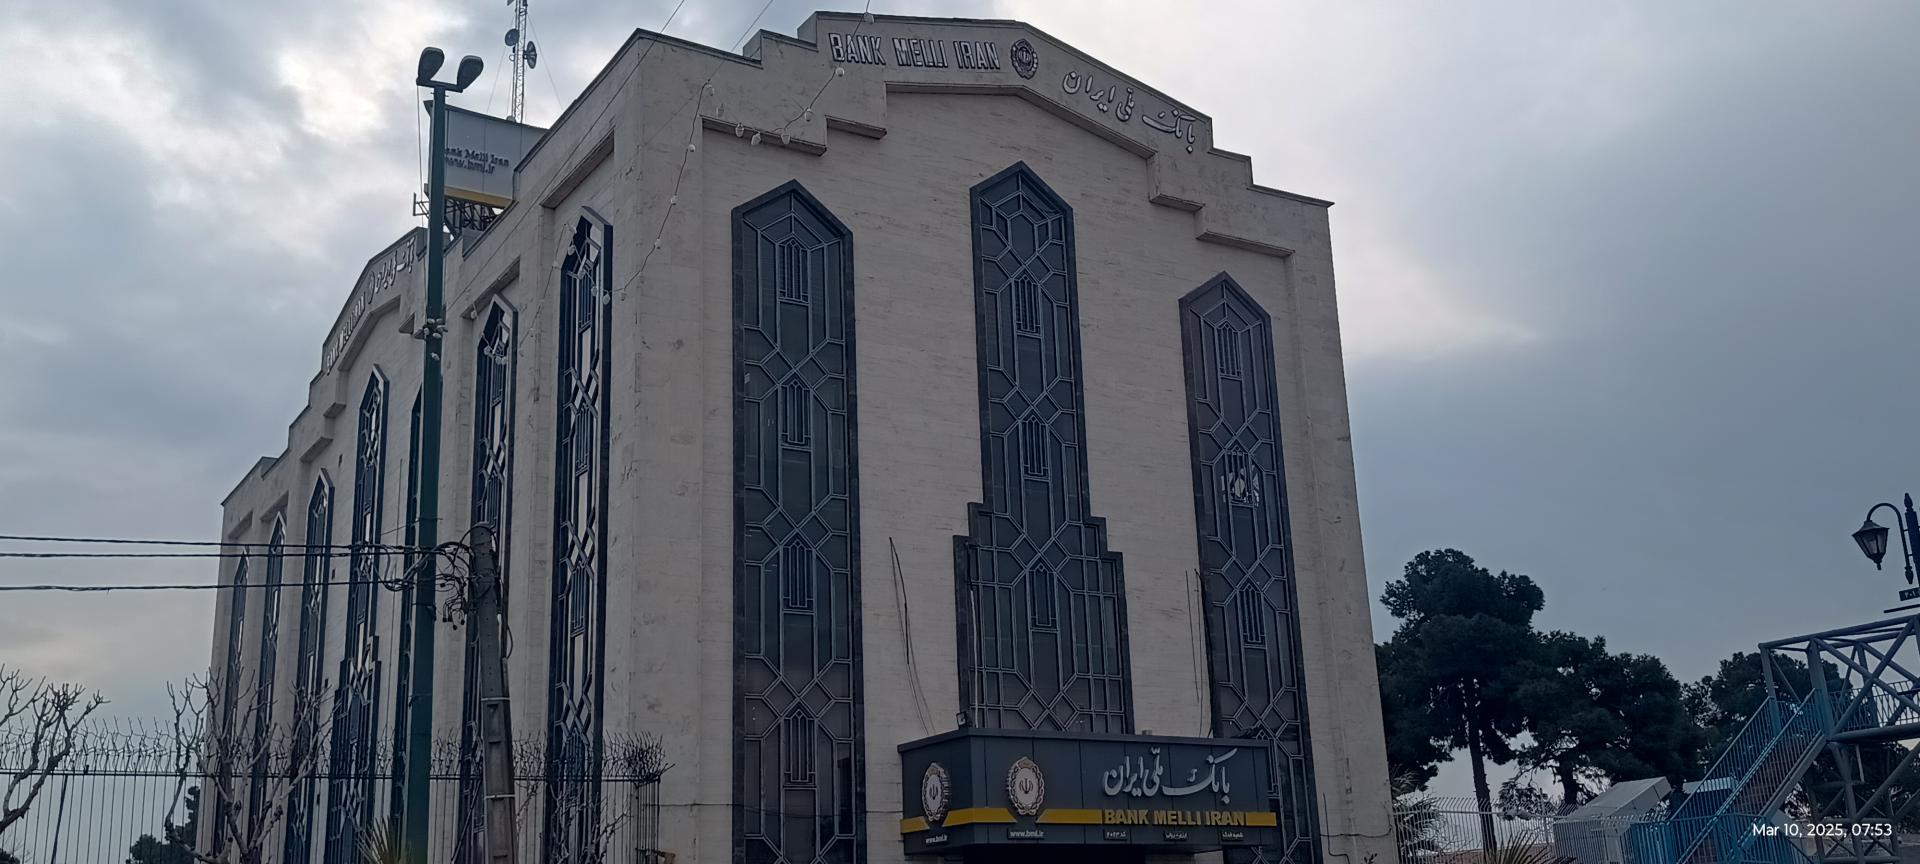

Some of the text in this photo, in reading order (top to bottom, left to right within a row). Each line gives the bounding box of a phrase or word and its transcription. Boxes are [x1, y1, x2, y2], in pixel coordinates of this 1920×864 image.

[829, 33, 1000, 69] BANK MELLI IRAN
[1062, 71, 1116, 112] ایران
[1142, 109, 1196, 154] بانک
[1103, 756, 1143, 797] ایران
[1161, 748, 1238, 804] بانک
[1103, 809, 1247, 825] BANK MELLI IRAN
